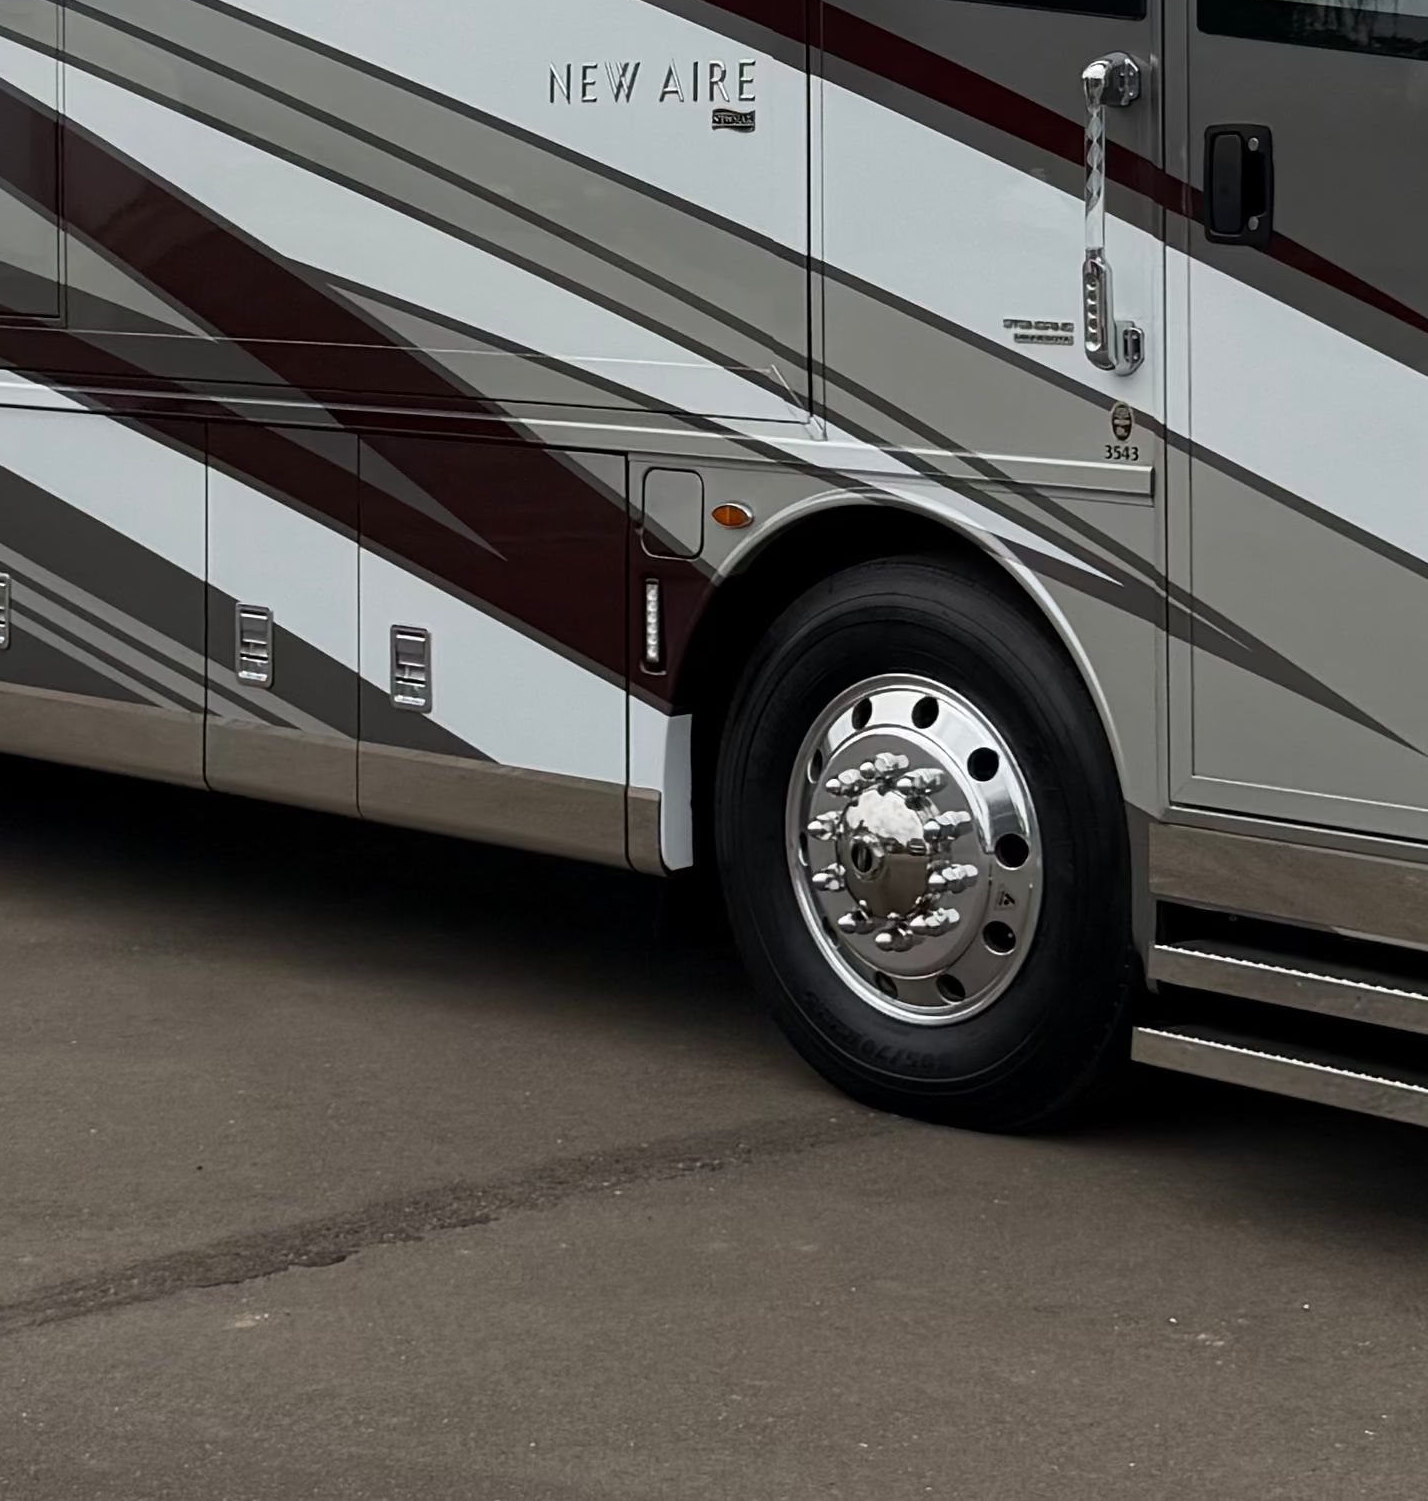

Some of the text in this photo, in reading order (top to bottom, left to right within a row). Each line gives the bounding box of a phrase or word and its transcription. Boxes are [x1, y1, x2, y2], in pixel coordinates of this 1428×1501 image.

[549, 58, 756, 104] NEW AIRE
[1104, 444, 1139, 461] 3543
